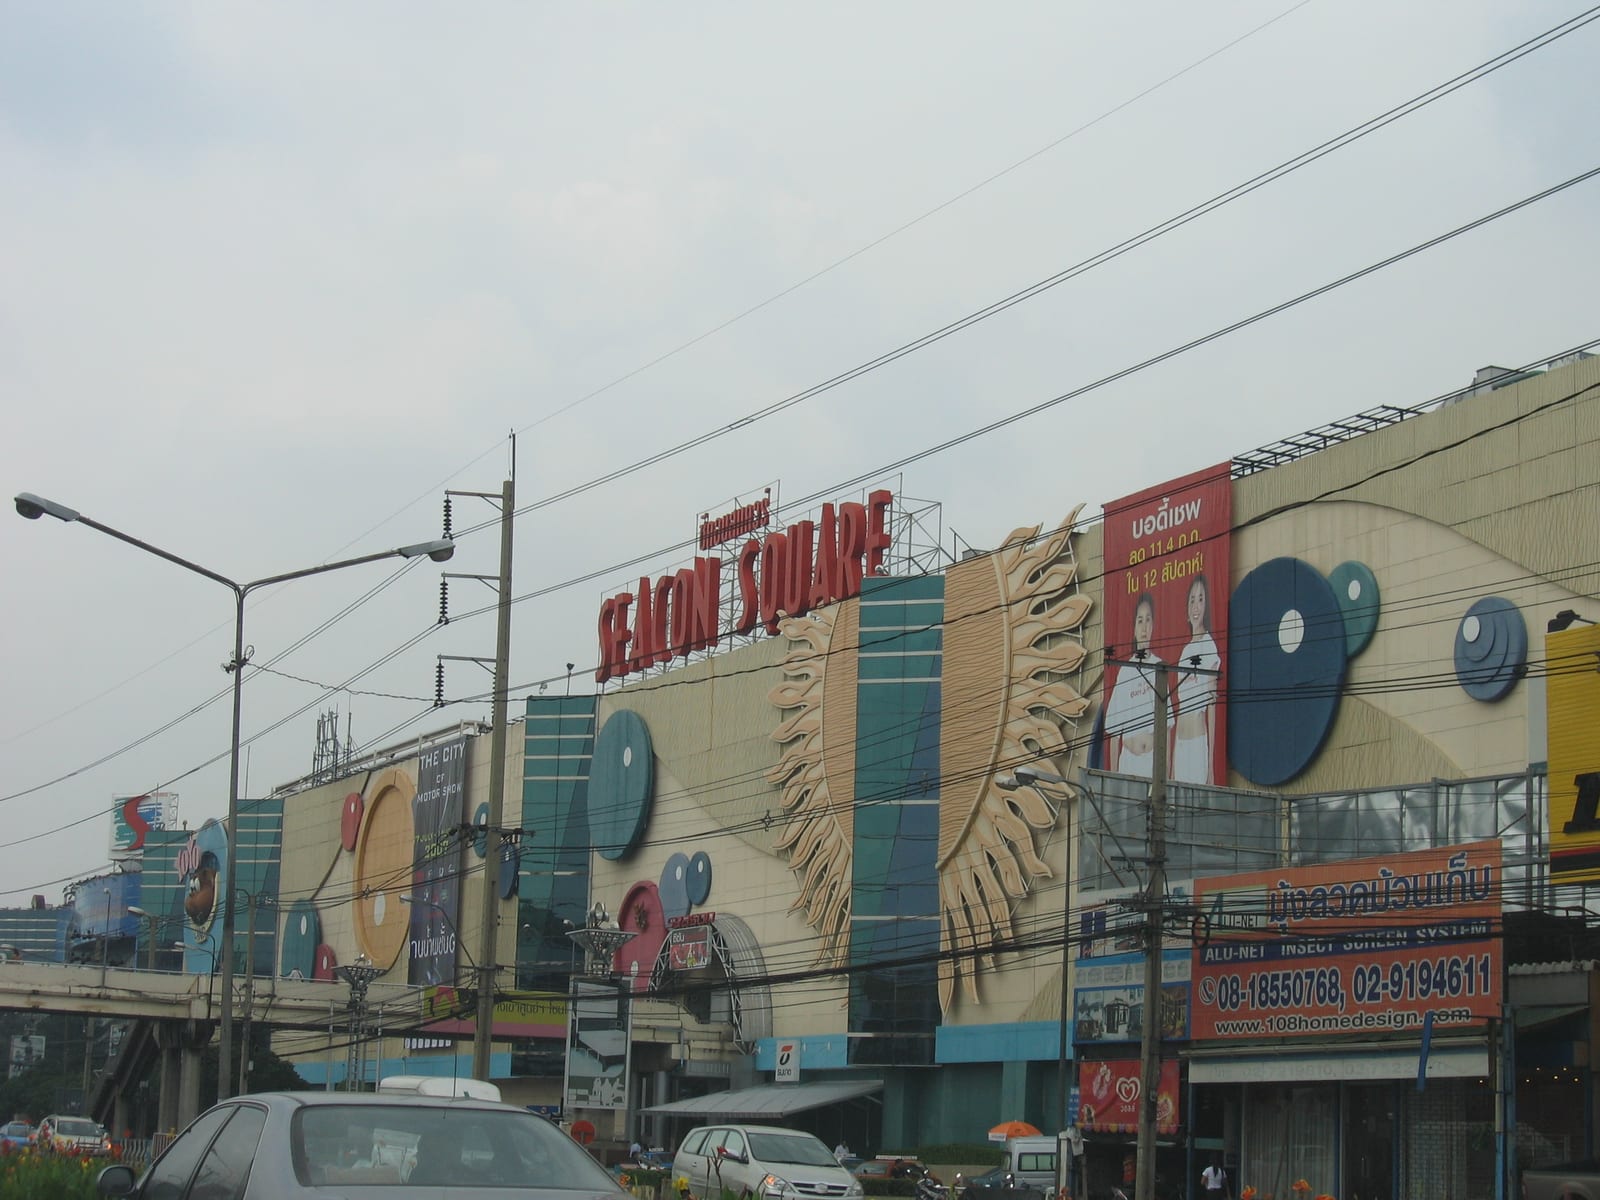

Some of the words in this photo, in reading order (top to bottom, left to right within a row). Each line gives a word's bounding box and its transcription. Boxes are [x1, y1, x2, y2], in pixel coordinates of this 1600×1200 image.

[1131, 497, 1202, 540] บอดี้เชพ
[1129, 547, 1146, 567] ลด
[1149, 537, 1175, 557] 11.4
[595, 556, 721, 683] SEACON
[736, 489, 893, 635] SQUARE
[1126, 572, 1140, 594] ใน
[1143, 569, 1158, 588] 12
[419, 750, 440, 771] THE
[442, 742, 467, 764] CITY
[416, 789, 441, 804] MOTOR
[1268, 851, 1491, 935] มุ้งลวดม้วนเก็บ
[1204, 944, 1265, 962] ALU-NET
[1281, 938, 1334, 956] INSECT
[1416, 921, 1487, 944] SYSTEM
[1216, 965, 1346, 1014] 08-18550768,
[1353, 952, 1492, 1004] 02-9194611
